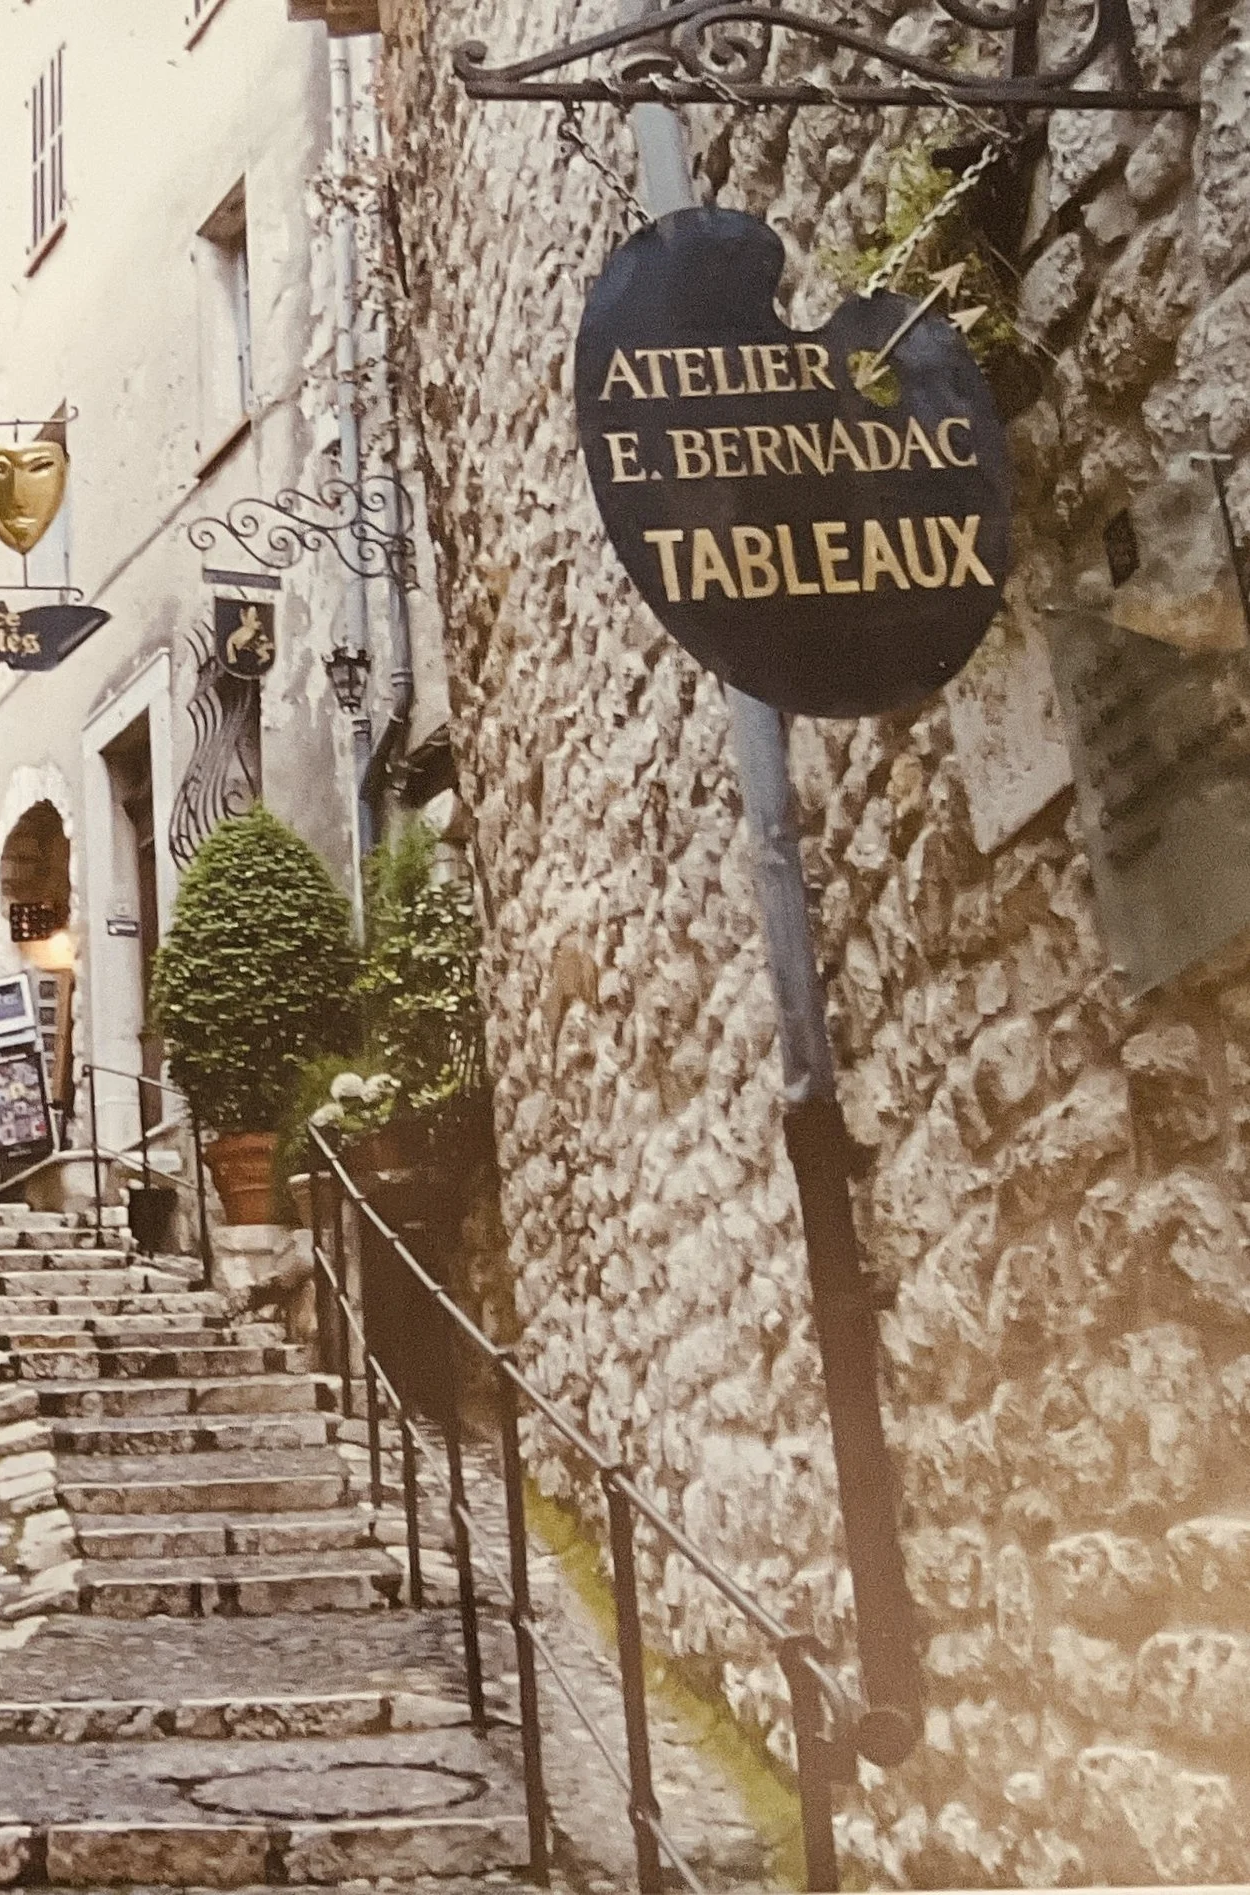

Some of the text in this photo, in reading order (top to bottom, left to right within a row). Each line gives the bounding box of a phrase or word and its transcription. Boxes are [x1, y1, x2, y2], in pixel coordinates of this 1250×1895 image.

[598, 342, 836, 400] ATELIER
[603, 416, 978, 483] E. BERNADAC
[643, 514, 995, 602] TABLEAUX
